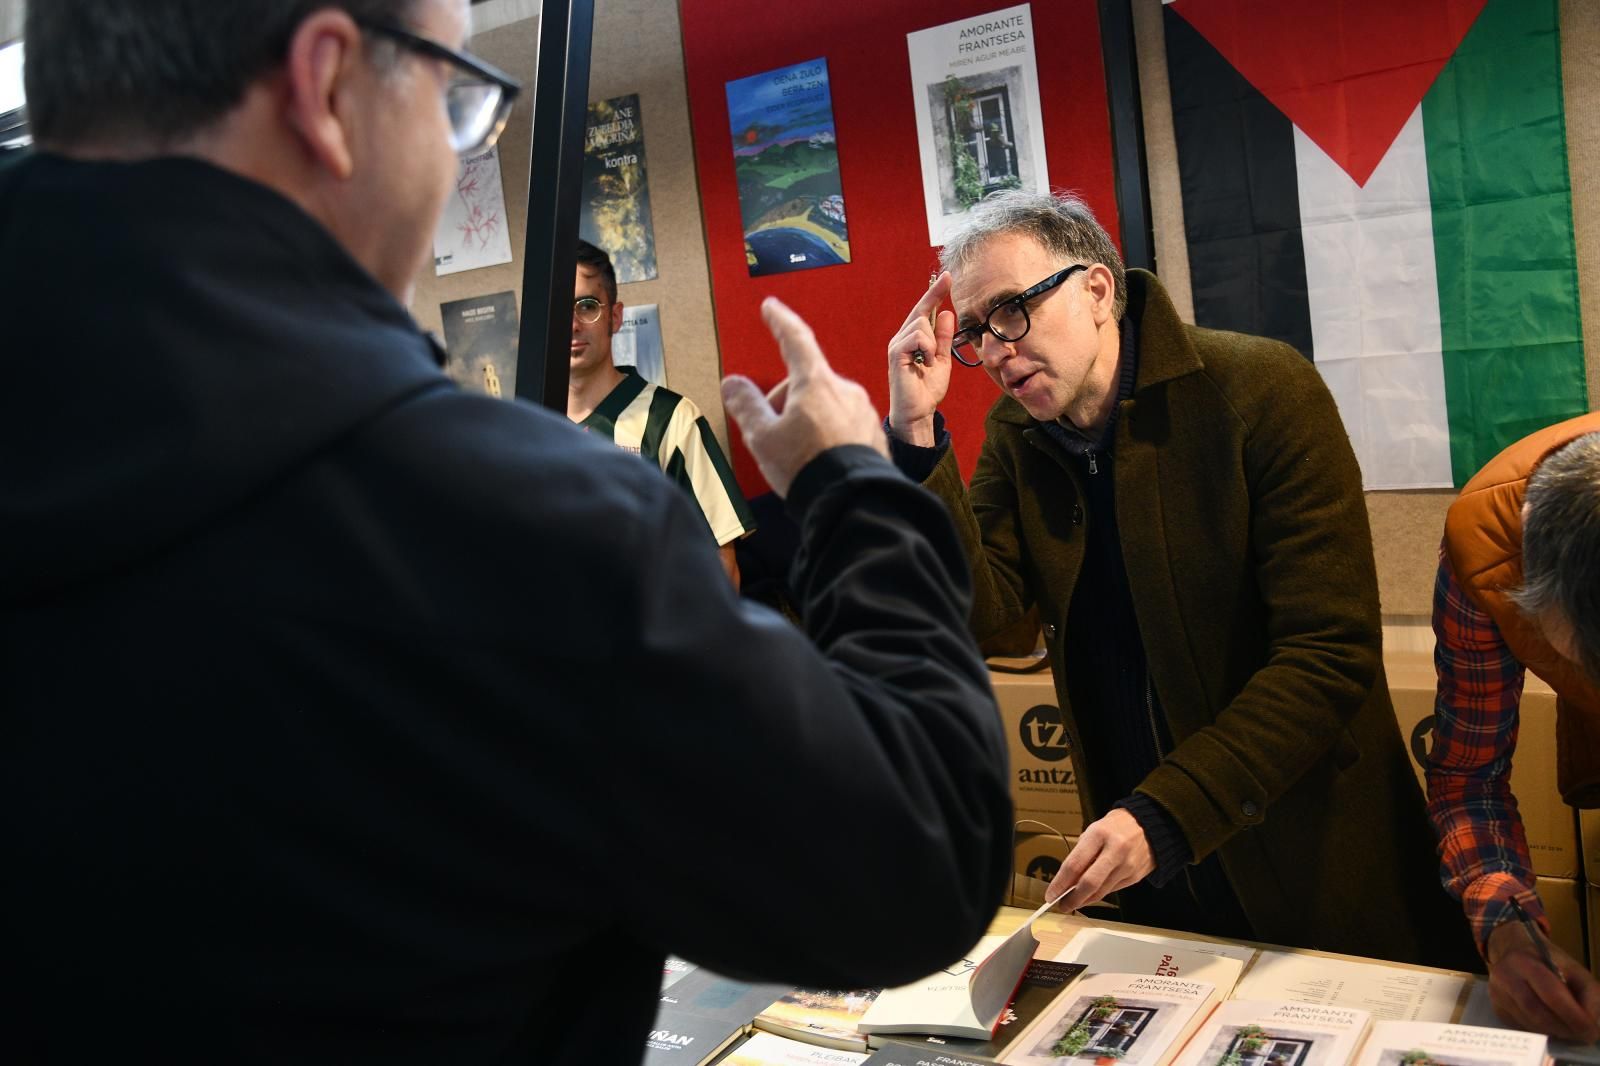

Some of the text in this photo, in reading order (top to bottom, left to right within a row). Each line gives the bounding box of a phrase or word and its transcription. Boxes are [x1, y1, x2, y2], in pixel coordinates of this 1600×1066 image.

[960, 15, 1024, 40] AMORANTE
[958, 30, 1025, 54] FRANTSESA
[999, 45, 1027, 57] MEABE
[774, 73, 798, 86] DENA
[808, 80, 825, 91] ZEN
[613, 107, 633, 121] ANE
[605, 154, 638, 168] kontra
[1027, 716, 1069, 748] tz
[1019, 768, 1077, 785] antz
[1167, 966, 1179, 977] 16
[1128, 984, 1199, 996] FRANTSESA
[1136, 978, 1204, 990] AMORANTE
[1273, 1011, 1354, 1025] FRANTSESA
[1280, 1005, 1358, 1018] AMORANTE
